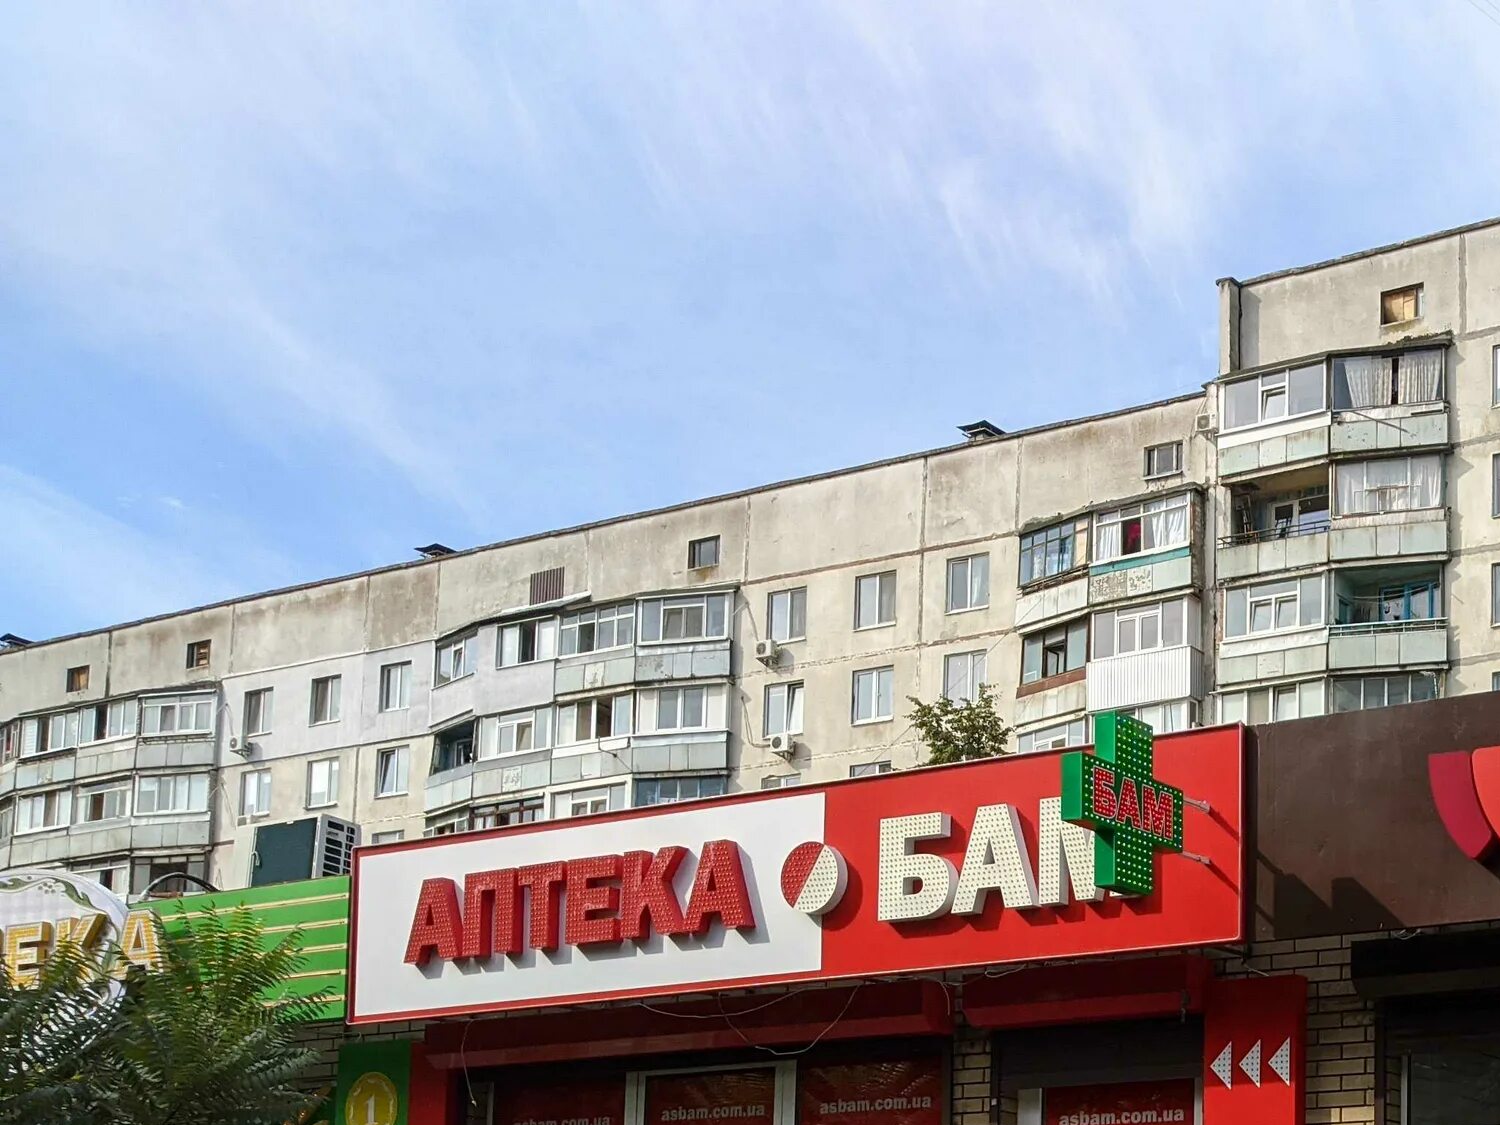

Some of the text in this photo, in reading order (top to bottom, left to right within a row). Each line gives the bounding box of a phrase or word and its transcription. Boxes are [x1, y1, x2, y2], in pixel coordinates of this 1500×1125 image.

[1092, 765, 1174, 840] БАМ
[404, 840, 757, 965] АПТЕКА
[0, 905, 168, 991] ЕКА
[661, 1102, 765, 1121] asbam.com.ua
[819, 1096, 931, 1115] asbam.com.ua
